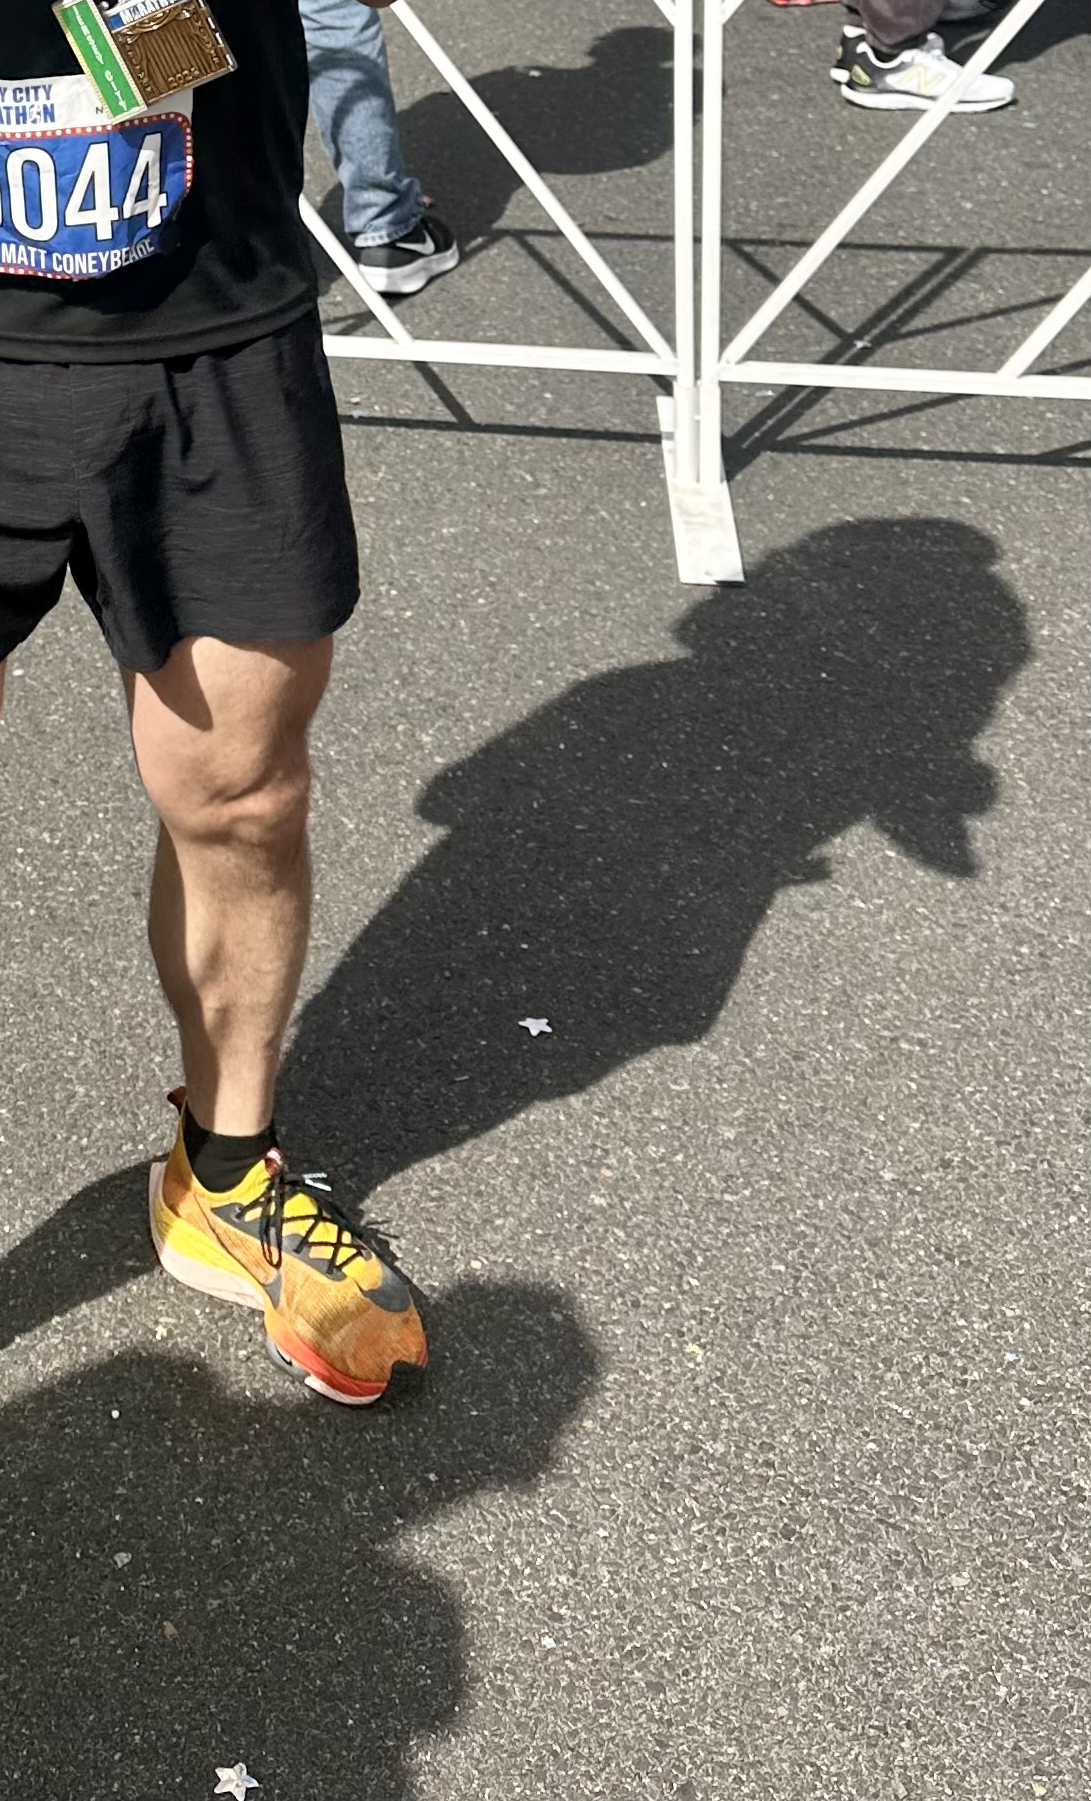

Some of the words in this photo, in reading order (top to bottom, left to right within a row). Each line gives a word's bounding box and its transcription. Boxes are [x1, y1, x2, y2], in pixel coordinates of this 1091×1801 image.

[12, 83, 53, 103] CITY
[104, 70, 128, 111] CITY
[1, 242, 48, 270] MATT
